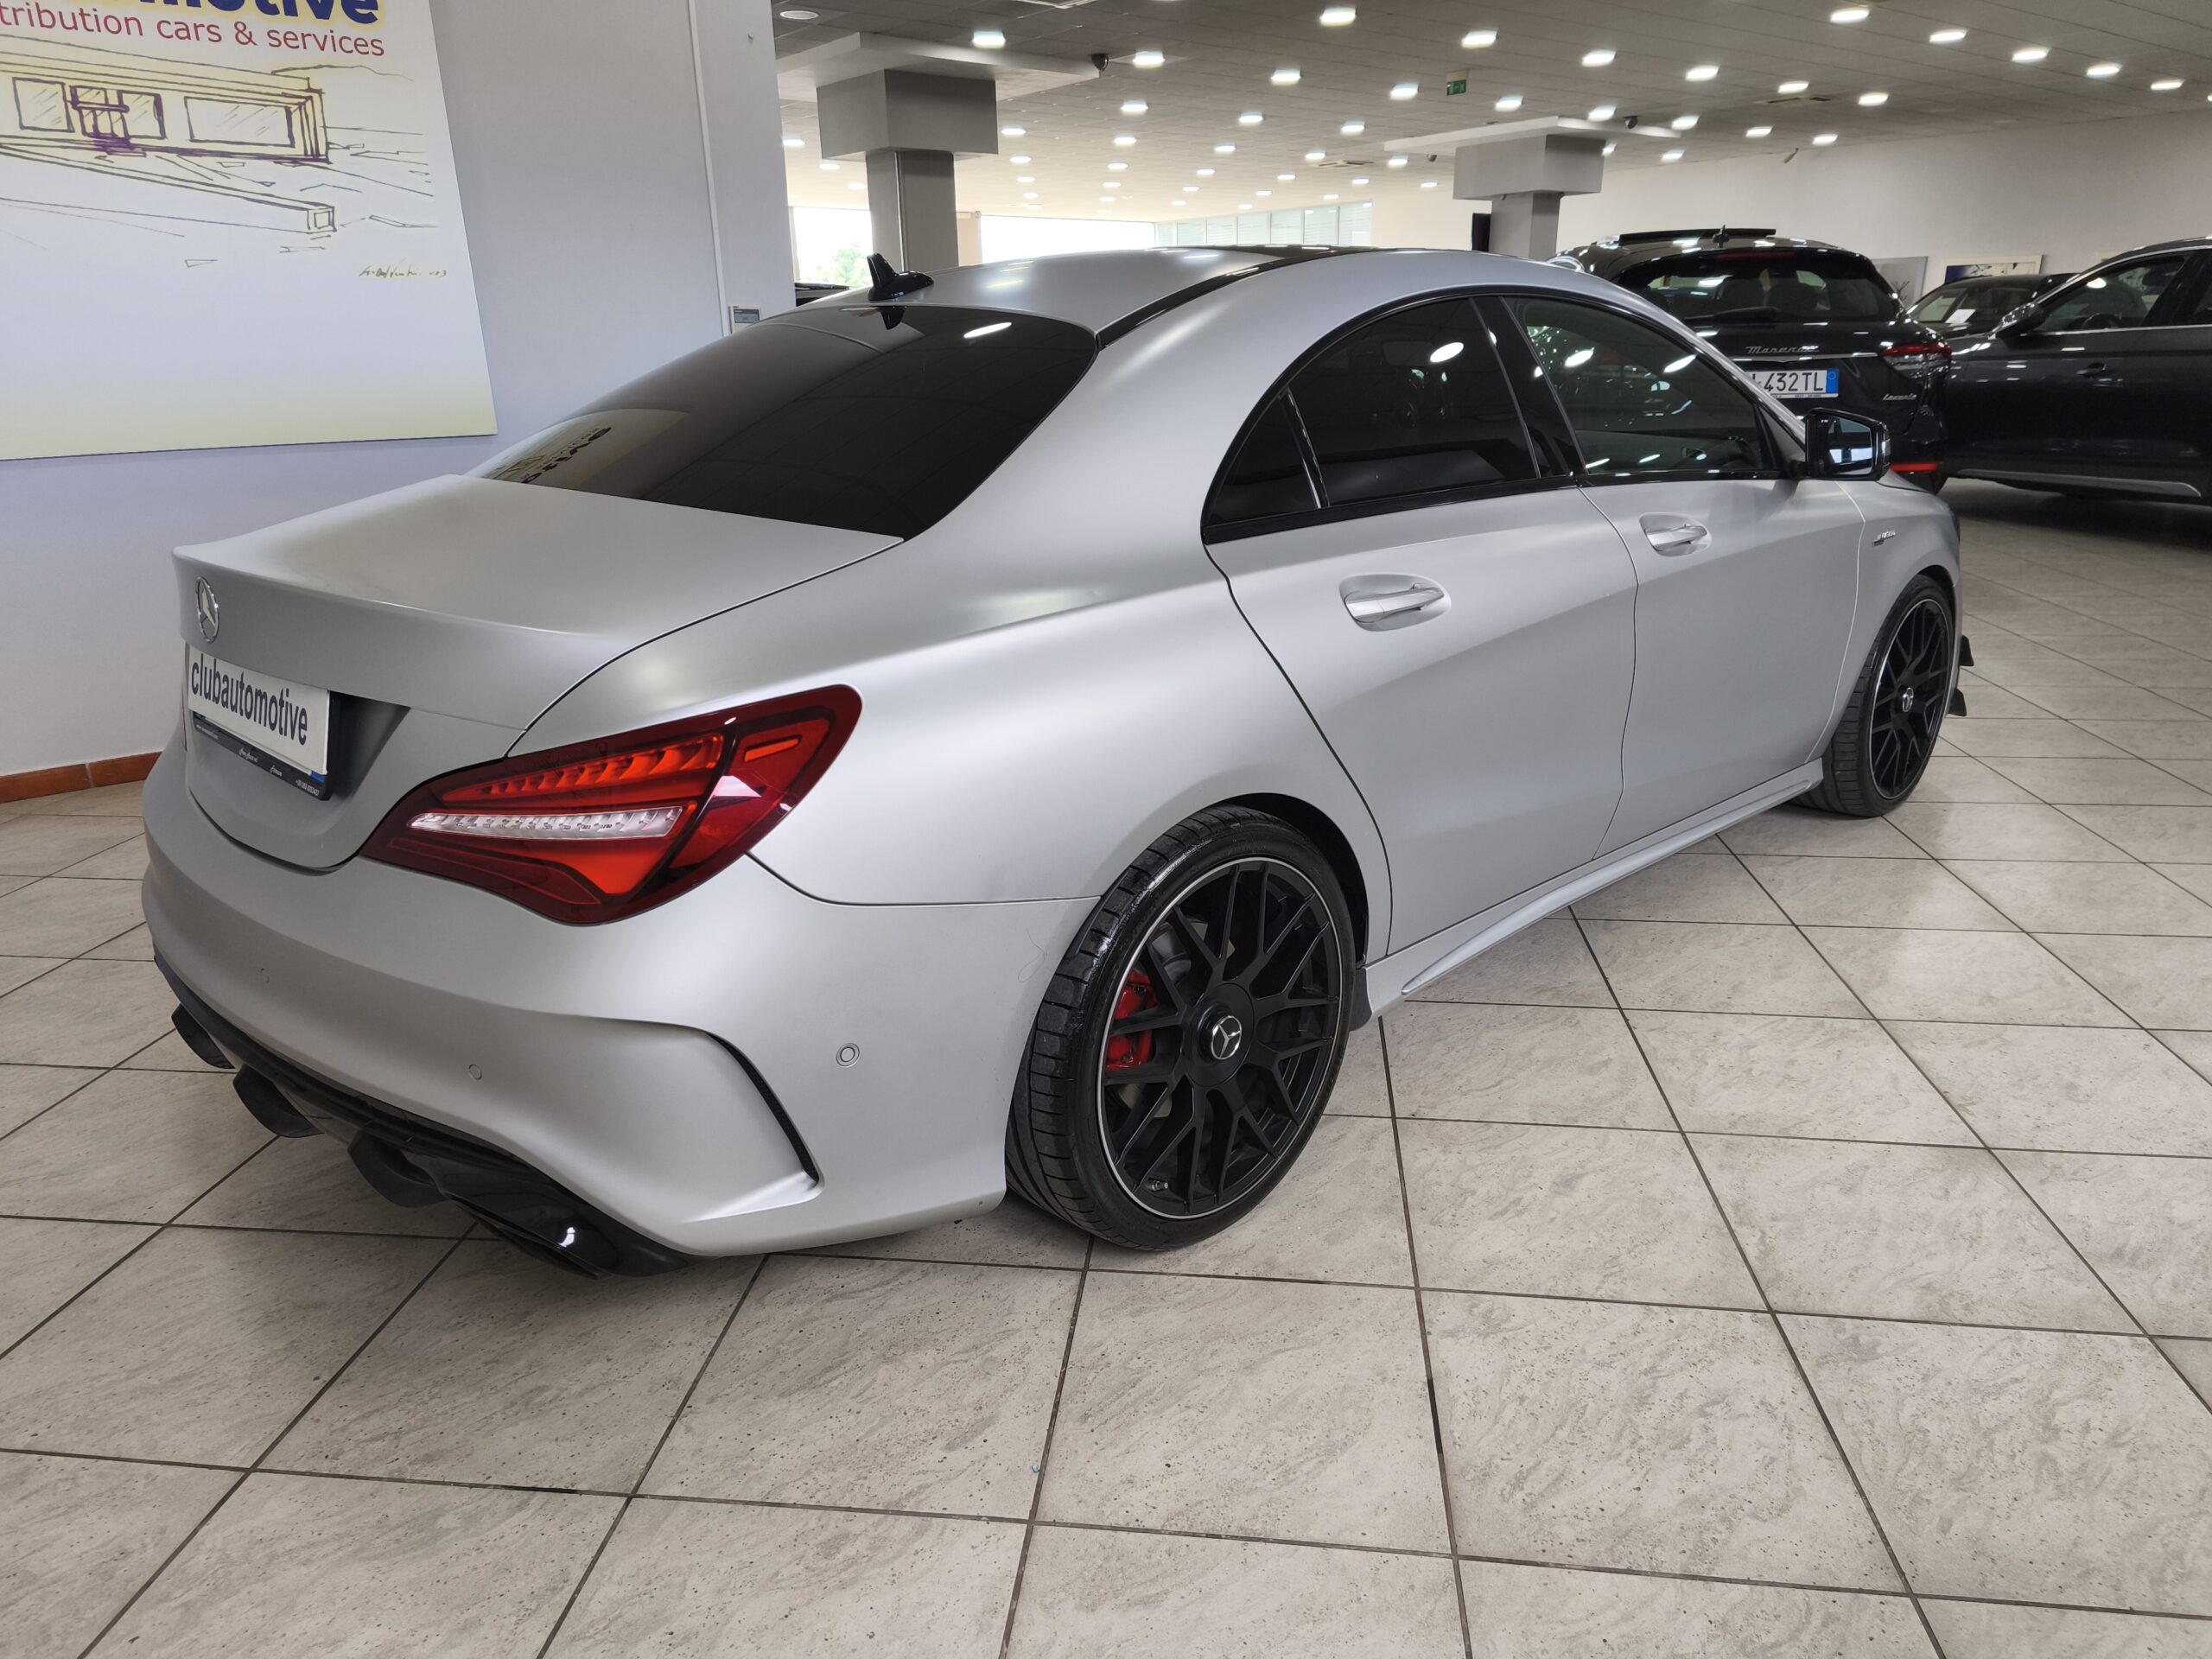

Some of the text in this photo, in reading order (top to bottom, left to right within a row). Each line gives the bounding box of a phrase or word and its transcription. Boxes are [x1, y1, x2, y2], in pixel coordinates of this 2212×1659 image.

[156, 19, 222, 42] cars
[234, 21, 257, 46] &
[267, 29, 385, 56] services
[191, 653, 308, 746] clubautomotive
